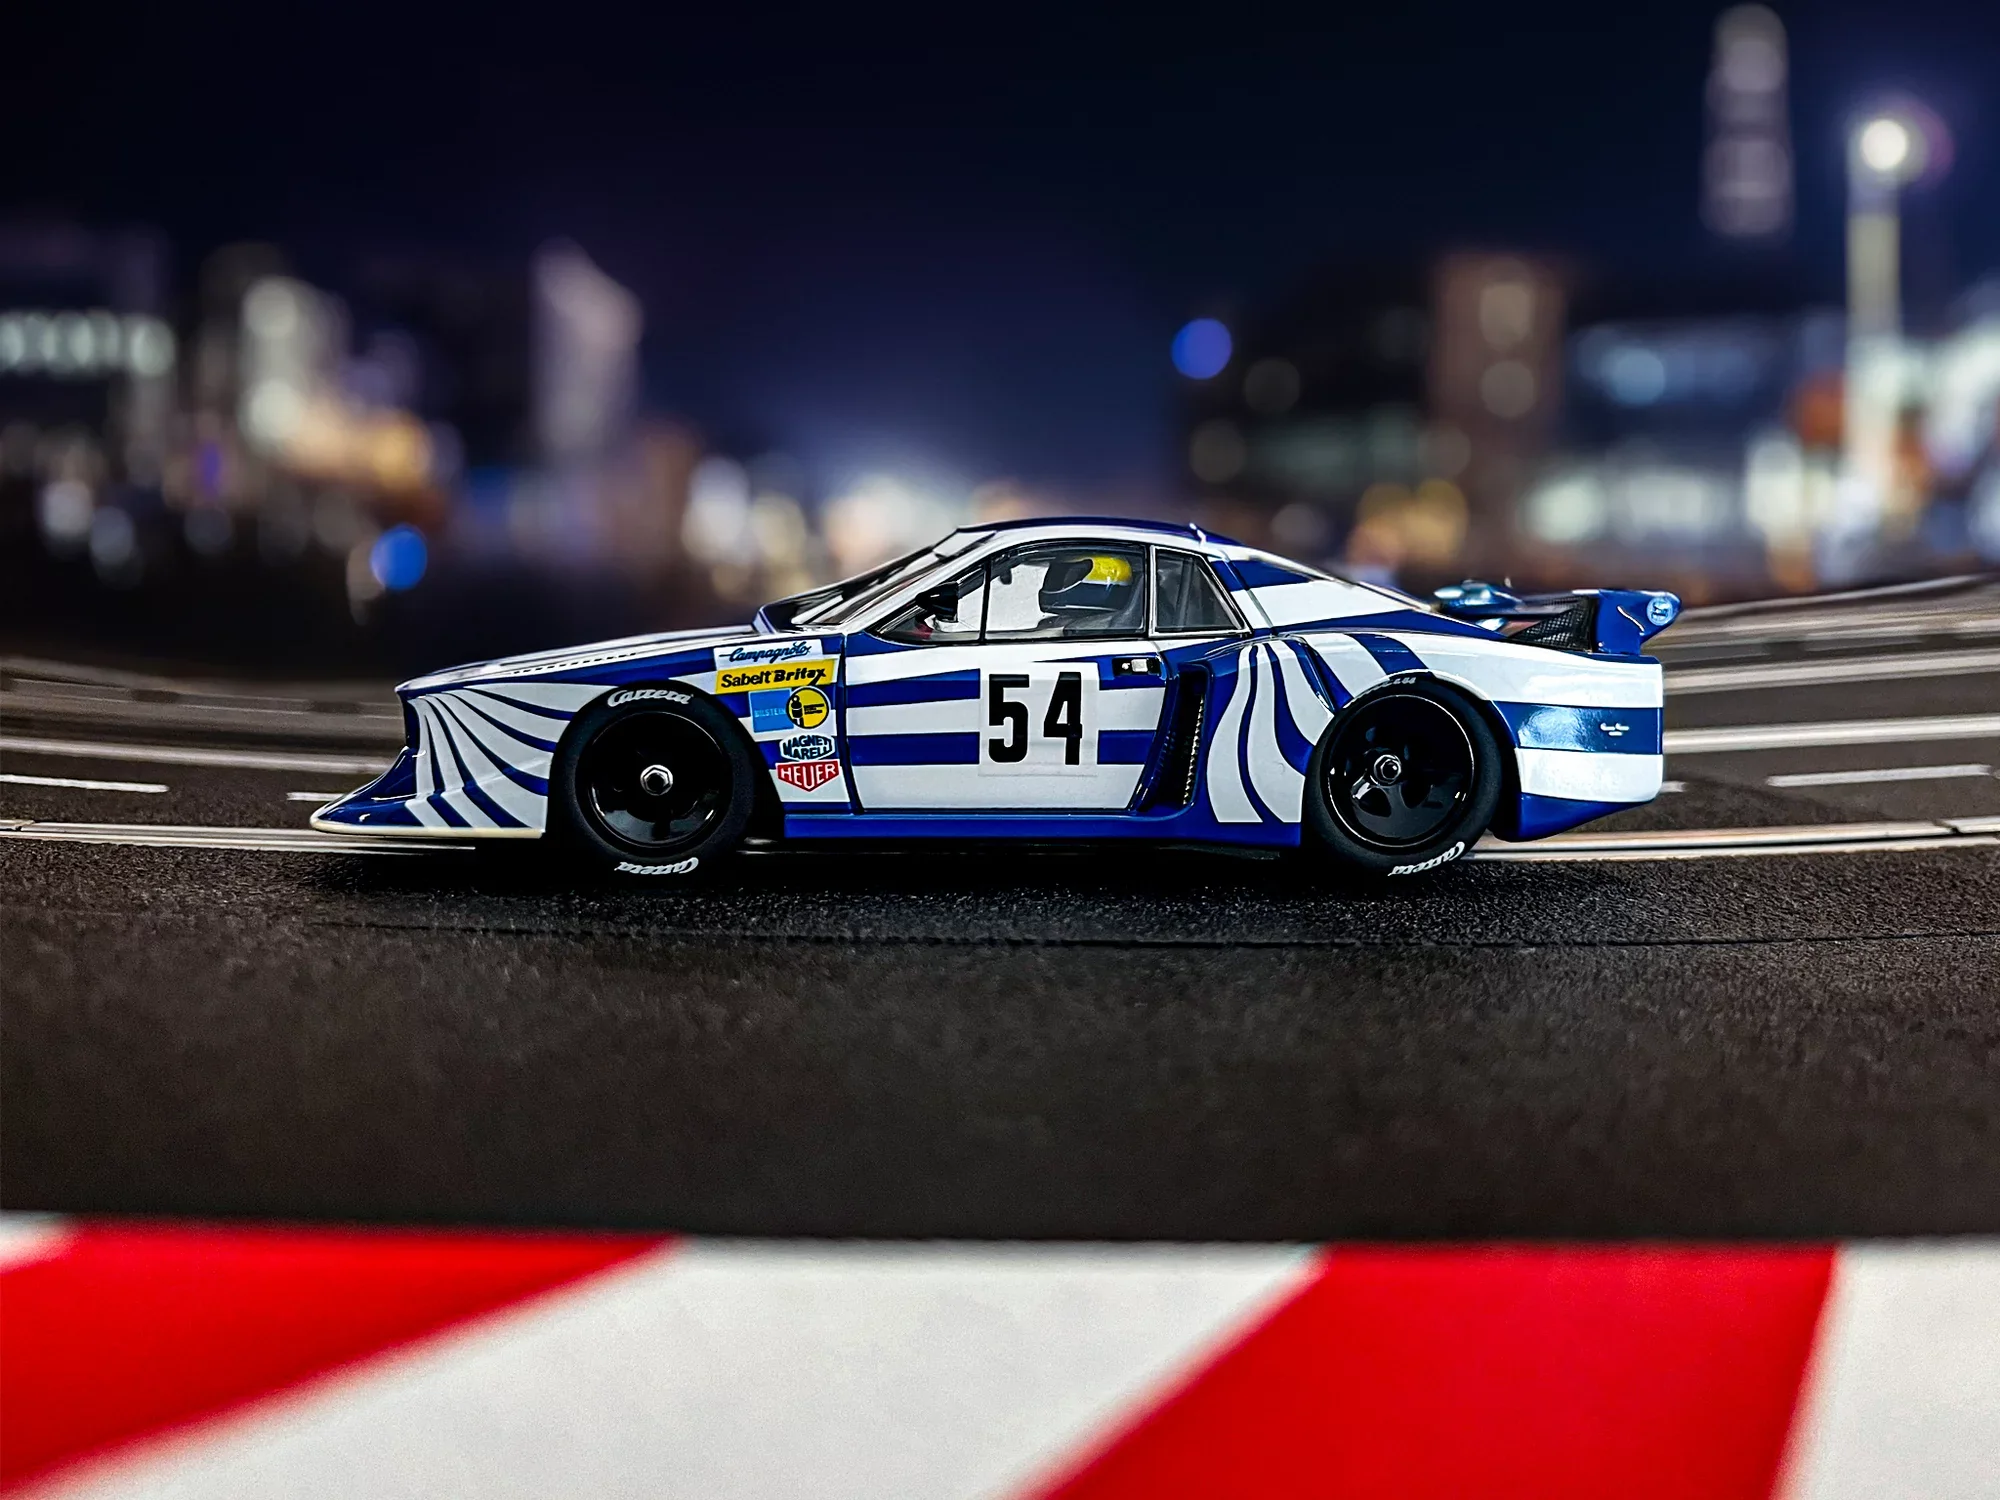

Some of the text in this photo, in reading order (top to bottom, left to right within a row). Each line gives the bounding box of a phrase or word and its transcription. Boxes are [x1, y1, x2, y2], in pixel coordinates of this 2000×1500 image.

[721, 667, 827, 688] Sabelt Britax
[607, 688, 692, 707] Carrera
[988, 671, 1083, 766] 54
[780, 763, 837, 789] HEUER
[613, 856, 699, 875] Carrera
[1387, 840, 1466, 877] Carrera
